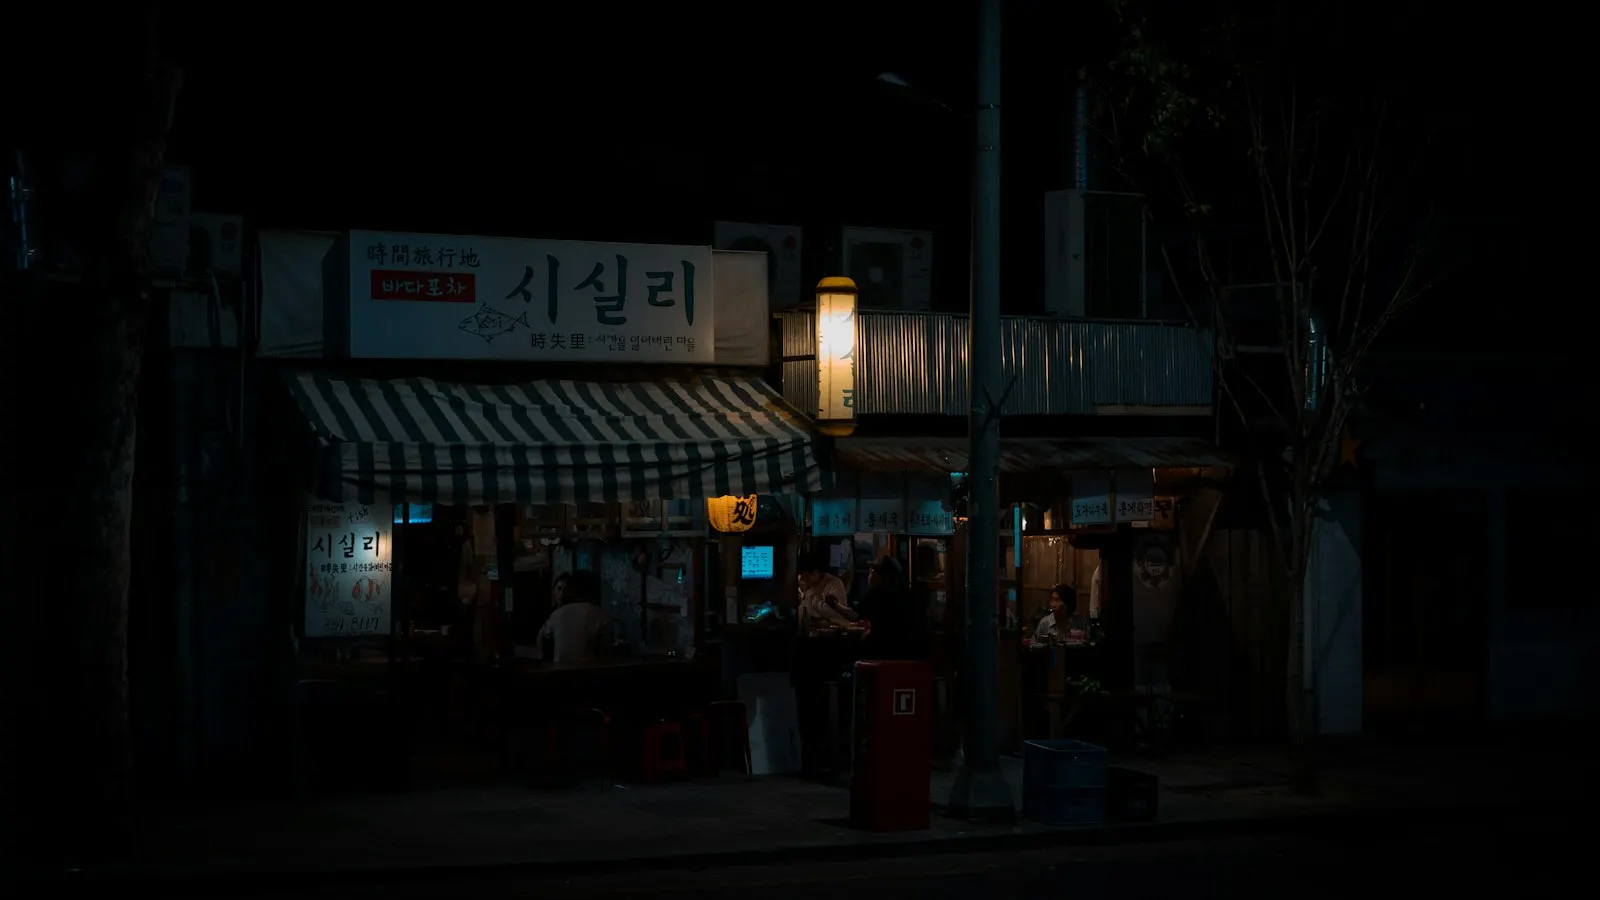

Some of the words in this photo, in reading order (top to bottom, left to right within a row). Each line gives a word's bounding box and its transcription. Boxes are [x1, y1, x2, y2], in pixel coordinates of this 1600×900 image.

[366, 242, 480, 268] 時間旅行地
[381, 275, 467, 297] 바다포차
[505, 254, 696, 326] 시실리
[596, 334, 627, 351] 시간을
[677, 336, 696, 352] 마을
[311, 531, 380, 558] 시실리
